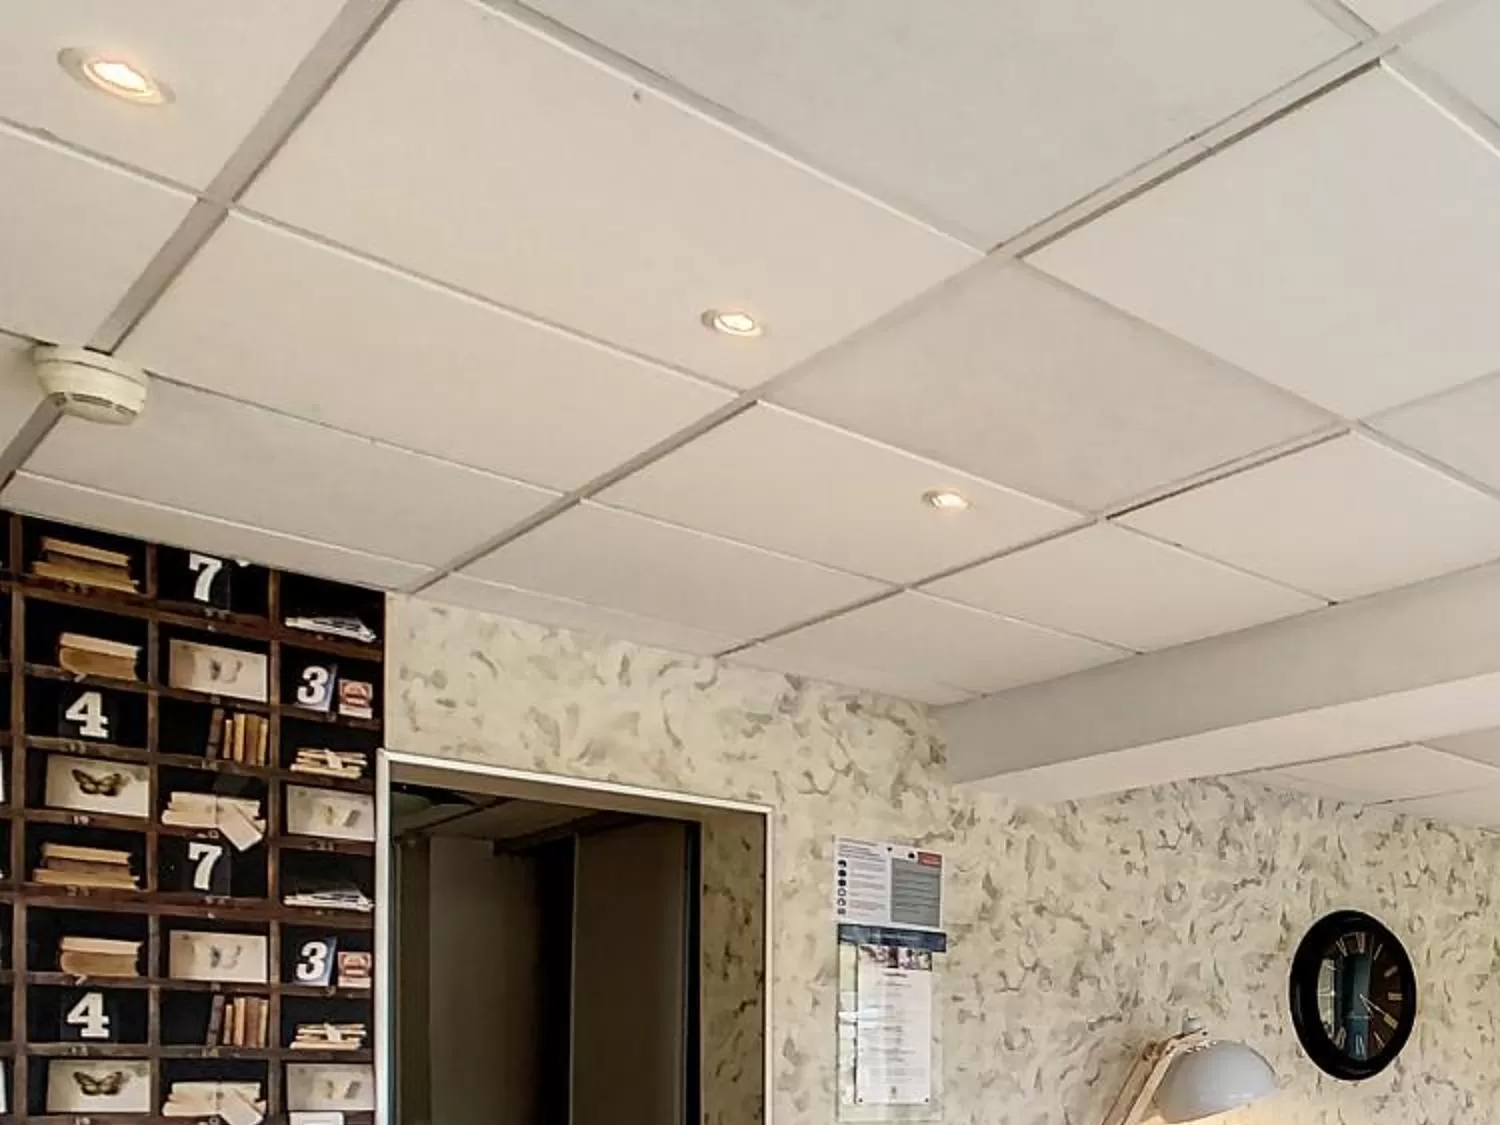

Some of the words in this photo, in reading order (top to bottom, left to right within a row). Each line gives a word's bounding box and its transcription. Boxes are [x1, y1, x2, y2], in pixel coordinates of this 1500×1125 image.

[189, 552, 223, 602] 7
[297, 665, 329, 705] 3
[65, 691, 109, 739] 4
[188, 841, 223, 891] 7
[296, 941, 328, 981] 3
[67, 991, 110, 1038] 4
